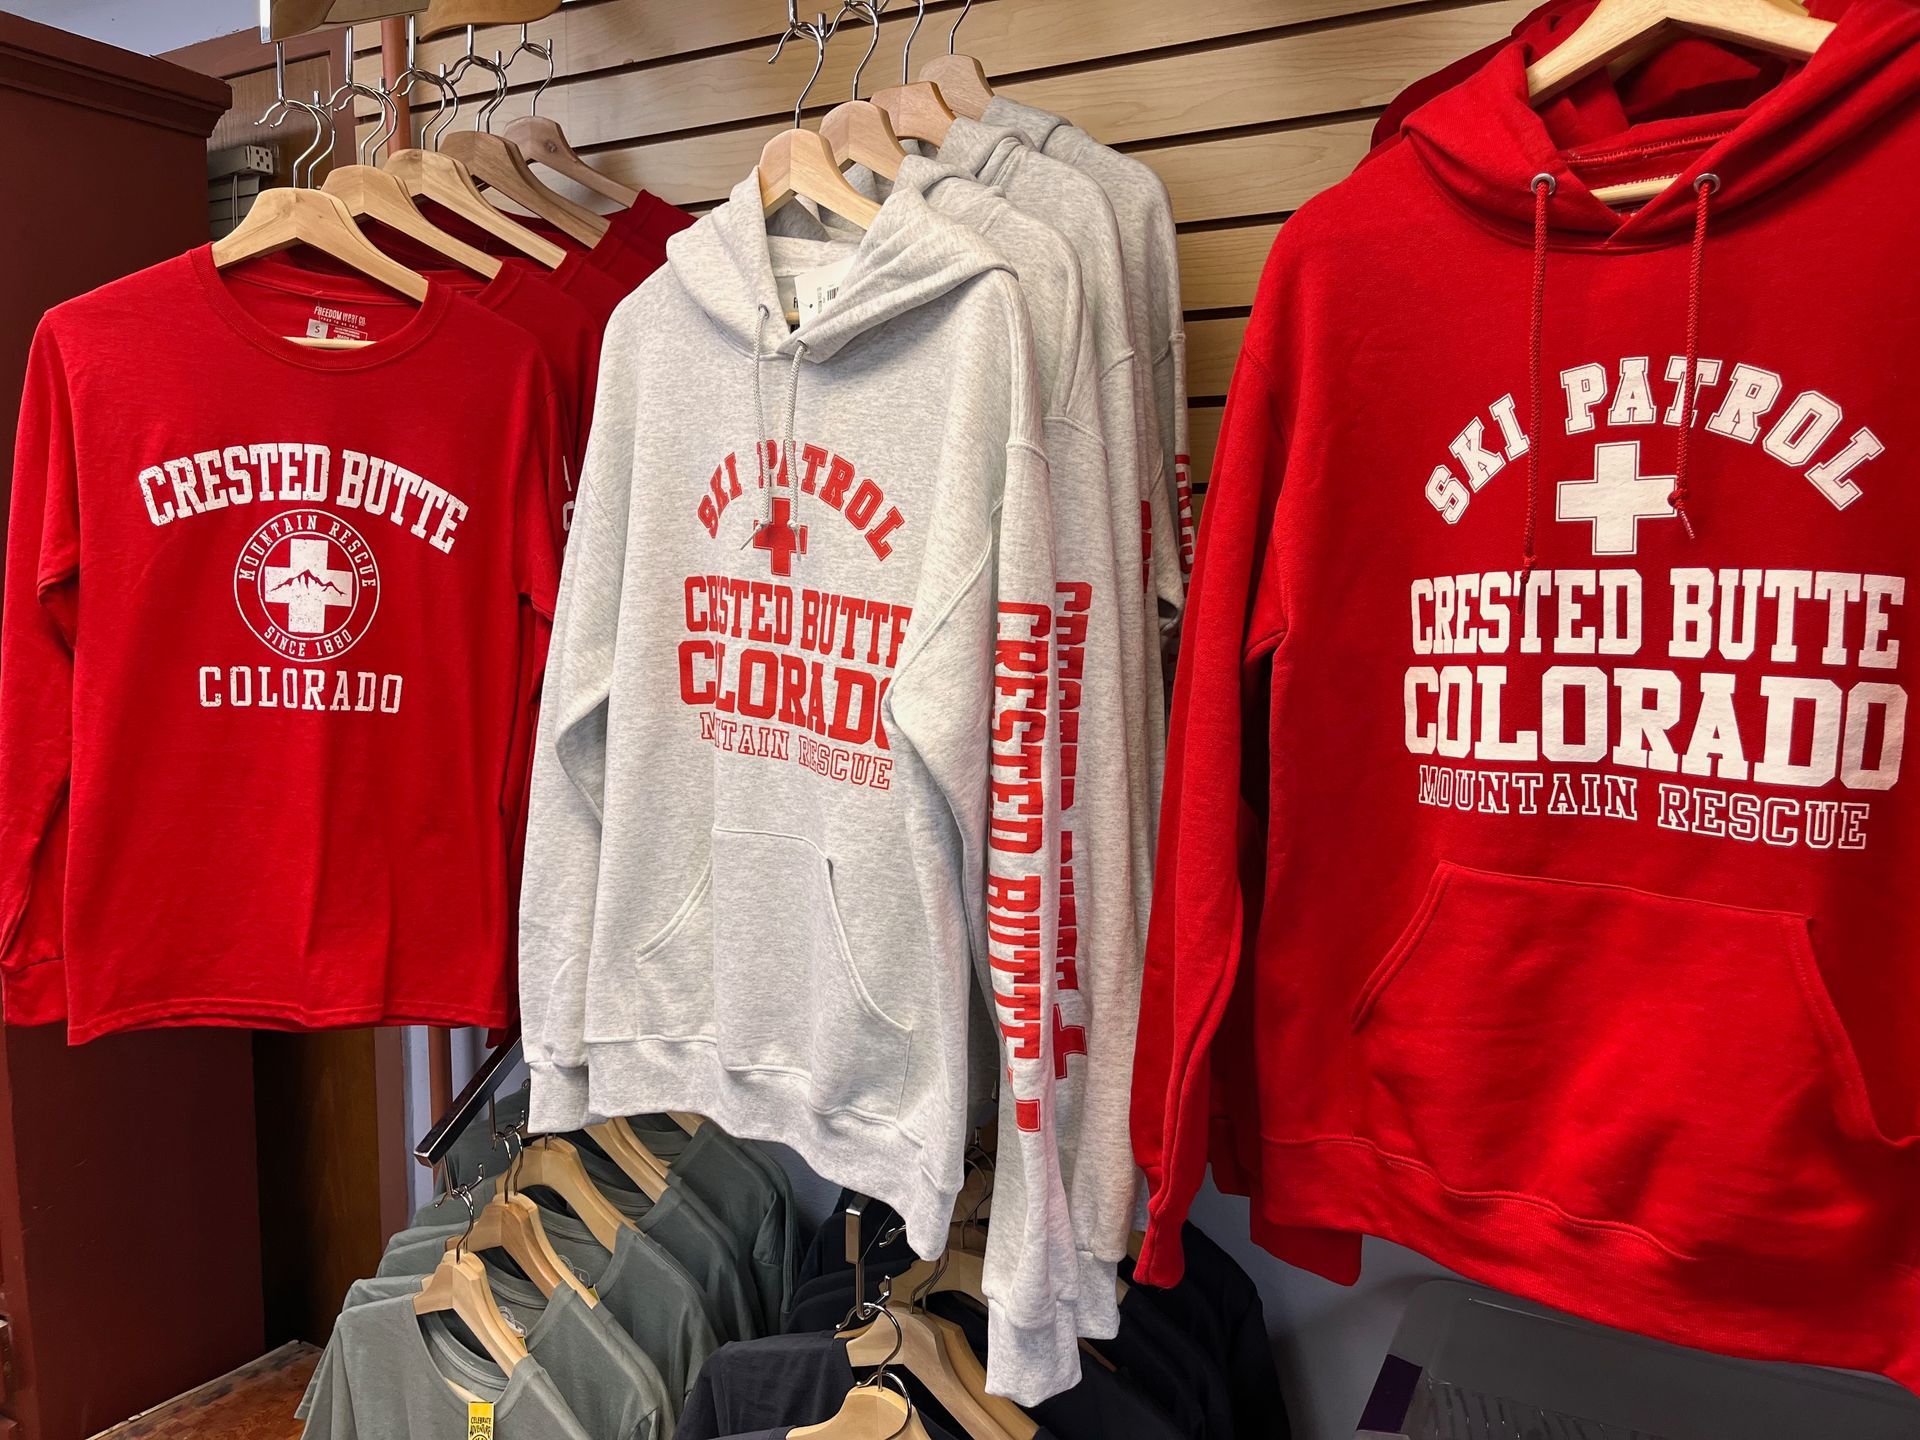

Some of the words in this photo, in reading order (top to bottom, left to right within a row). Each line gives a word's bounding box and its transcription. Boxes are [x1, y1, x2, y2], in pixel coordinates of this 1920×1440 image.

[314, 306, 343, 321] FREEDOM
[314, 325, 321, 334] S
[1425, 393, 1531, 525] SKI
[1560, 356, 1886, 511] PATROL
[138, 442, 331, 527] CRESTED
[336, 449, 469, 555] BUTTE
[697, 452, 743, 539] SKI
[756, 439, 905, 562] PATROL
[238, 514, 318, 582] MOUNTAIN
[328, 520, 376, 588] RESCUE
[264, 626, 306, 657] SINCE
[315, 628, 353, 656] 1880
[684, 575, 793, 644] CRSTED
[1410, 569, 1643, 655] CRESTED
[1667, 567, 1906, 669] BUTTE
[198, 666, 404, 714] COLORADO
[989, 601, 1052, 854] CRESTED
[1403, 665, 1909, 791] COLORADO
[799, 734, 893, 791] RESCUE
[1418, 764, 1638, 820] MOUNTAIN
[1657, 783, 1870, 850] RESCUE
